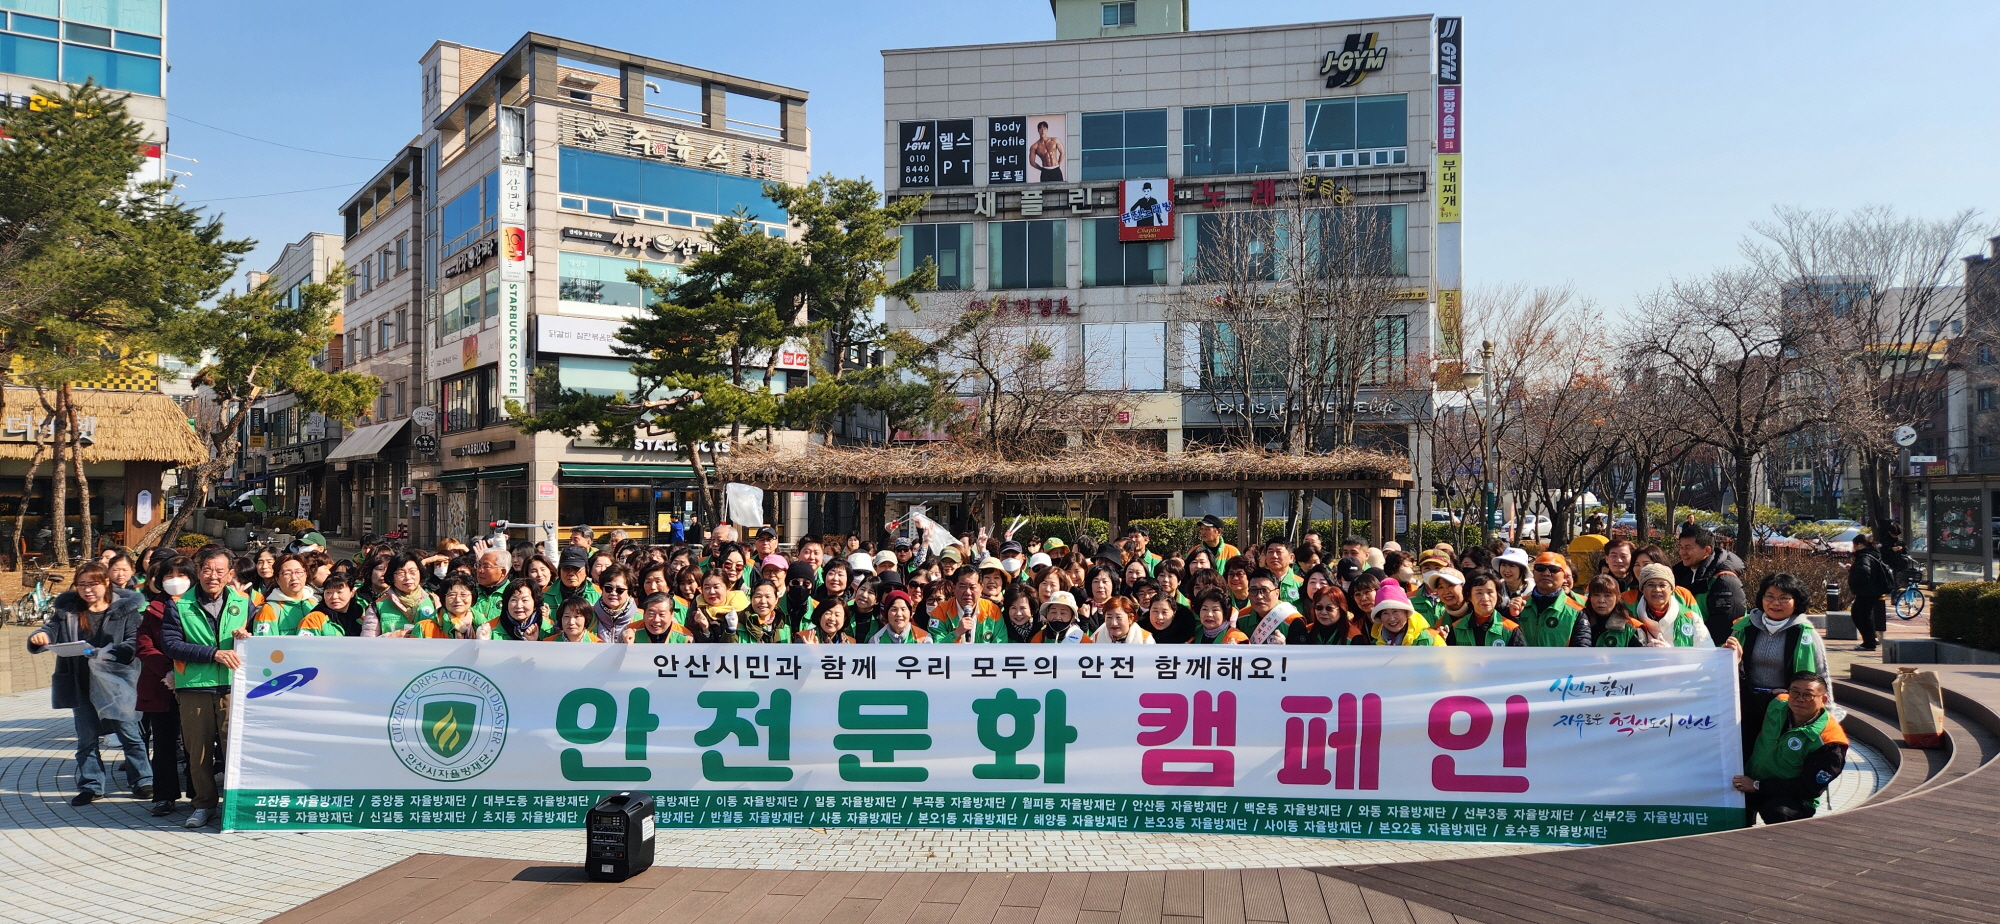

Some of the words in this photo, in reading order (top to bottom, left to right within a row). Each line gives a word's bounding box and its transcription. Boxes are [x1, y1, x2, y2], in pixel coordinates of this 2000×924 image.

[1321, 48, 1387, 74] J-GYM
[995, 121, 1021, 132] Body
[905, 141, 931, 151] J-GYM
[939, 132, 972, 151] 헬스
[991, 136, 1025, 147] Profile
[905, 165, 930, 173] 8440
[909, 154, 926, 163] 010
[996, 154, 1018, 166] 바디
[905, 175, 930, 184] 0426
[990, 169, 1024, 182] 프로필
[1442, 160, 1457, 206] 부대찌개
[506, 178, 522, 212] 삼계탕
[974, 187, 1093, 218] 채플린
[1202, 179, 1276, 207] 노래
[509, 283, 518, 349] STARBUCKS
[548, 329, 572, 339] 닭갈비
[509, 352, 518, 394] COFFEE
[461, 441, 490, 456] STARBUCKS
[653, 654, 802, 680] 안산시민과
[820, 655, 876, 680] 함께
[895, 655, 951, 680] 우리
[971, 655, 1058, 679] 모두의
[1078, 655, 1135, 680] 안전
[1155, 655, 1288, 682] 함께해요!
[1549, 674, 1599, 702] 시민과
[391, 700, 408, 743] CITIZEN
[404, 672, 439, 700] CORPS
[440, 669, 482, 686] ACTIVE
[479, 681, 494, 695] IN
[489, 693, 505, 745] DISASTER
[1553, 713, 1605, 739] 자유로운
[1609, 712, 1673, 737] 혁신도시
[1678, 714, 1718, 731] 안산
[556, 686, 1078, 784] 안전문화
[1136, 690, 1530, 794] 캠페인
[405, 753, 491, 779] 안산시자율방재단
[255, 796, 291, 807] 고잔동
[296, 795, 354, 807] 자율방재단
[371, 795, 404, 807] 중앙동
[410, 795, 466, 806] 자율방재단
[484, 795, 527, 807] 대부도동
[534, 796, 589, 807] 자율방재단
[717, 796, 737, 807] 이동
[744, 796, 798, 807] 자율방재단
[815, 796, 836, 807] 일동
[842, 796, 896, 807] 자율방재단
[913, 797, 945, 808] 부곡동
[951, 797, 1005, 808] 자율방재단
[1023, 797, 1055, 809] 월피동
[1061, 798, 1116, 810] 자율방재단
[1133, 800, 1165, 812] 안산동
[1172, 801, 1227, 813] 자율방재단
[1245, 803, 1278, 815] 백운동
[1284, 804, 1341, 816] 자율방재단
[1359, 805, 1381, 817] 와동
[1388, 806, 1446, 818] 자율방재단
[1464, 808, 1507, 820] 선부3동
[1514, 809, 1574, 820] 자율방재단
[1593, 810, 1637, 822] 선부2동
[1644, 811, 1708, 825] 자율방재단
[255, 811, 289, 823] 원곡동
[296, 812, 353, 823] 자율방재단
[370, 812, 403, 823] 신길동
[410, 811, 466, 823] 자율방재단
[483, 811, 516, 823] 초지동
[522, 811, 577, 823] 자율방재단
[711, 811, 743, 823] 반월동
[749, 812, 804, 823] 자율방재단
[820, 812, 841, 824] 사동
[847, 812, 902, 824] 자율방재단
[918, 813, 957, 824] 본오1동
[963, 813, 1017, 825] 자율방재단
[1034, 814, 1067, 826] 해양동
[1073, 815, 1128, 827] 자율방재단
[1145, 817, 1185, 829] 본오3동
[1191, 817, 1247, 830] 자율방재단
[1265, 820, 1298, 832] 사이동
[1305, 821, 1361, 833] 자율방재단
[1379, 822, 1421, 834] 본오2동
[1428, 823, 1487, 836] 자율방재단
[1505, 825, 1540, 837] 호수동
[1547, 825, 1608, 838] 자율방재단
